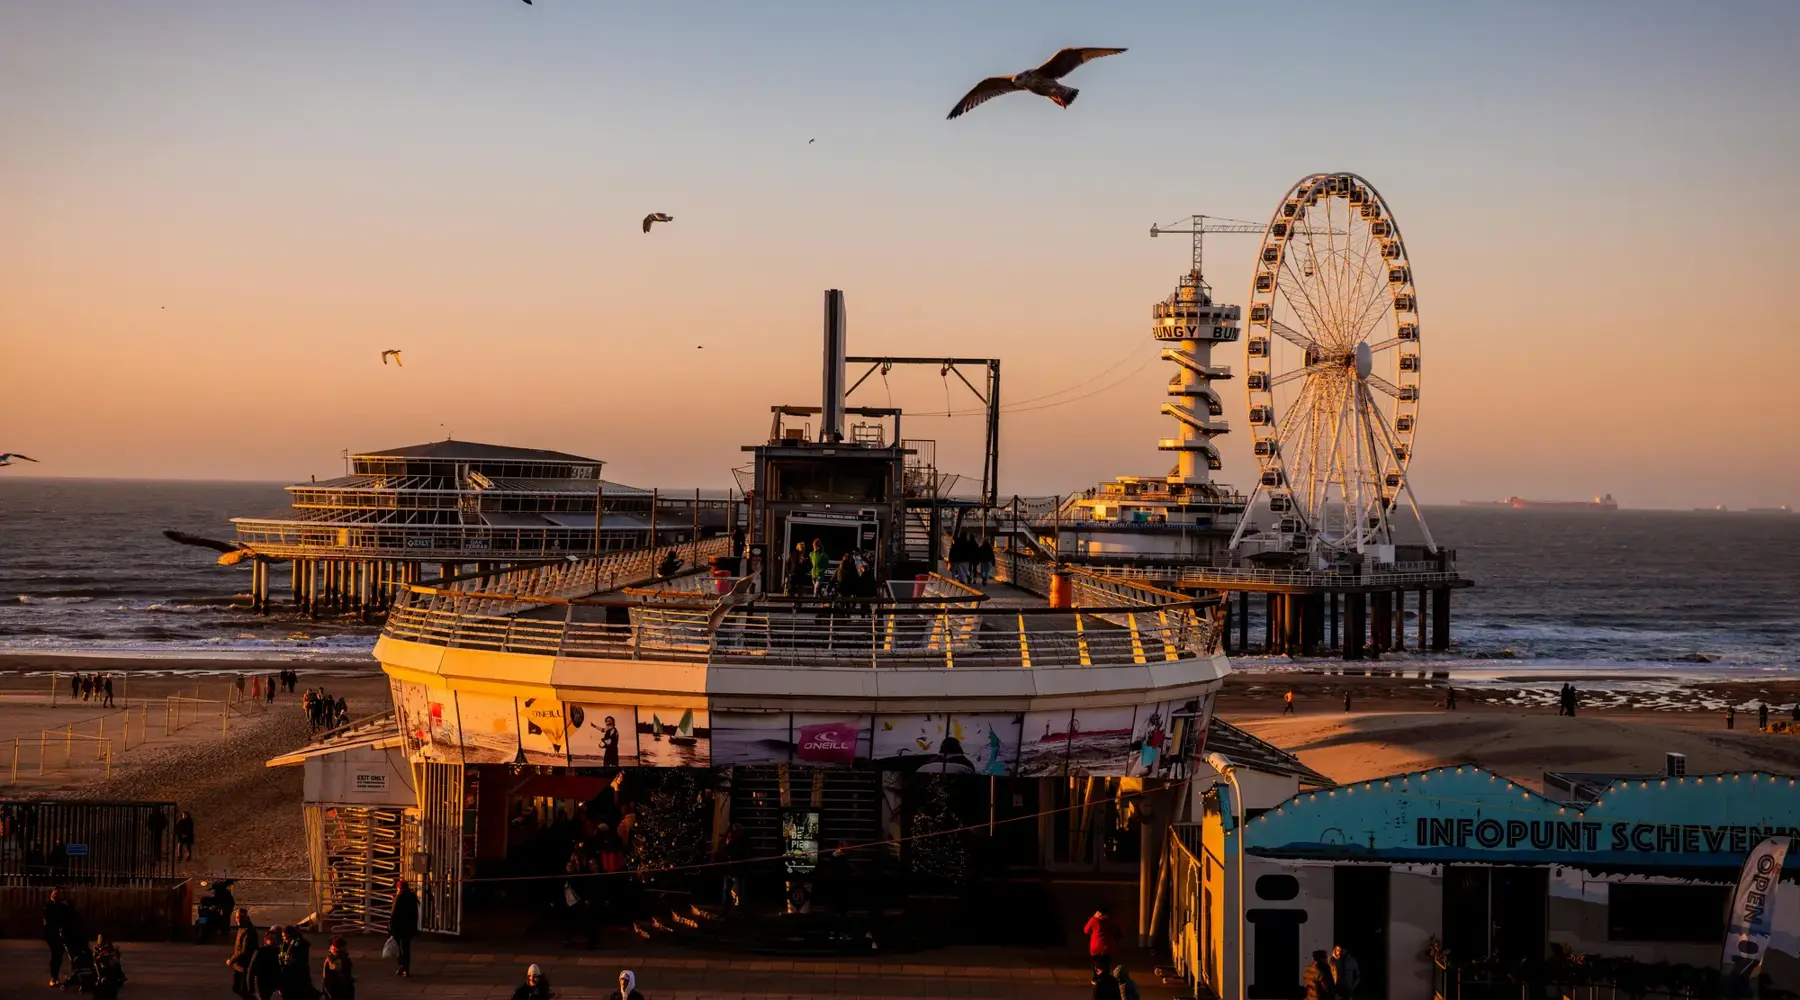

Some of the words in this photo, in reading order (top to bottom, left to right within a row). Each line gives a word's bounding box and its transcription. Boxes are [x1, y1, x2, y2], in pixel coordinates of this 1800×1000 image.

[1417, 818, 1602, 851] INFOPUNT
[1612, 822, 1800, 854] SCHEVEN
[1743, 854, 1775, 926] OPEN
